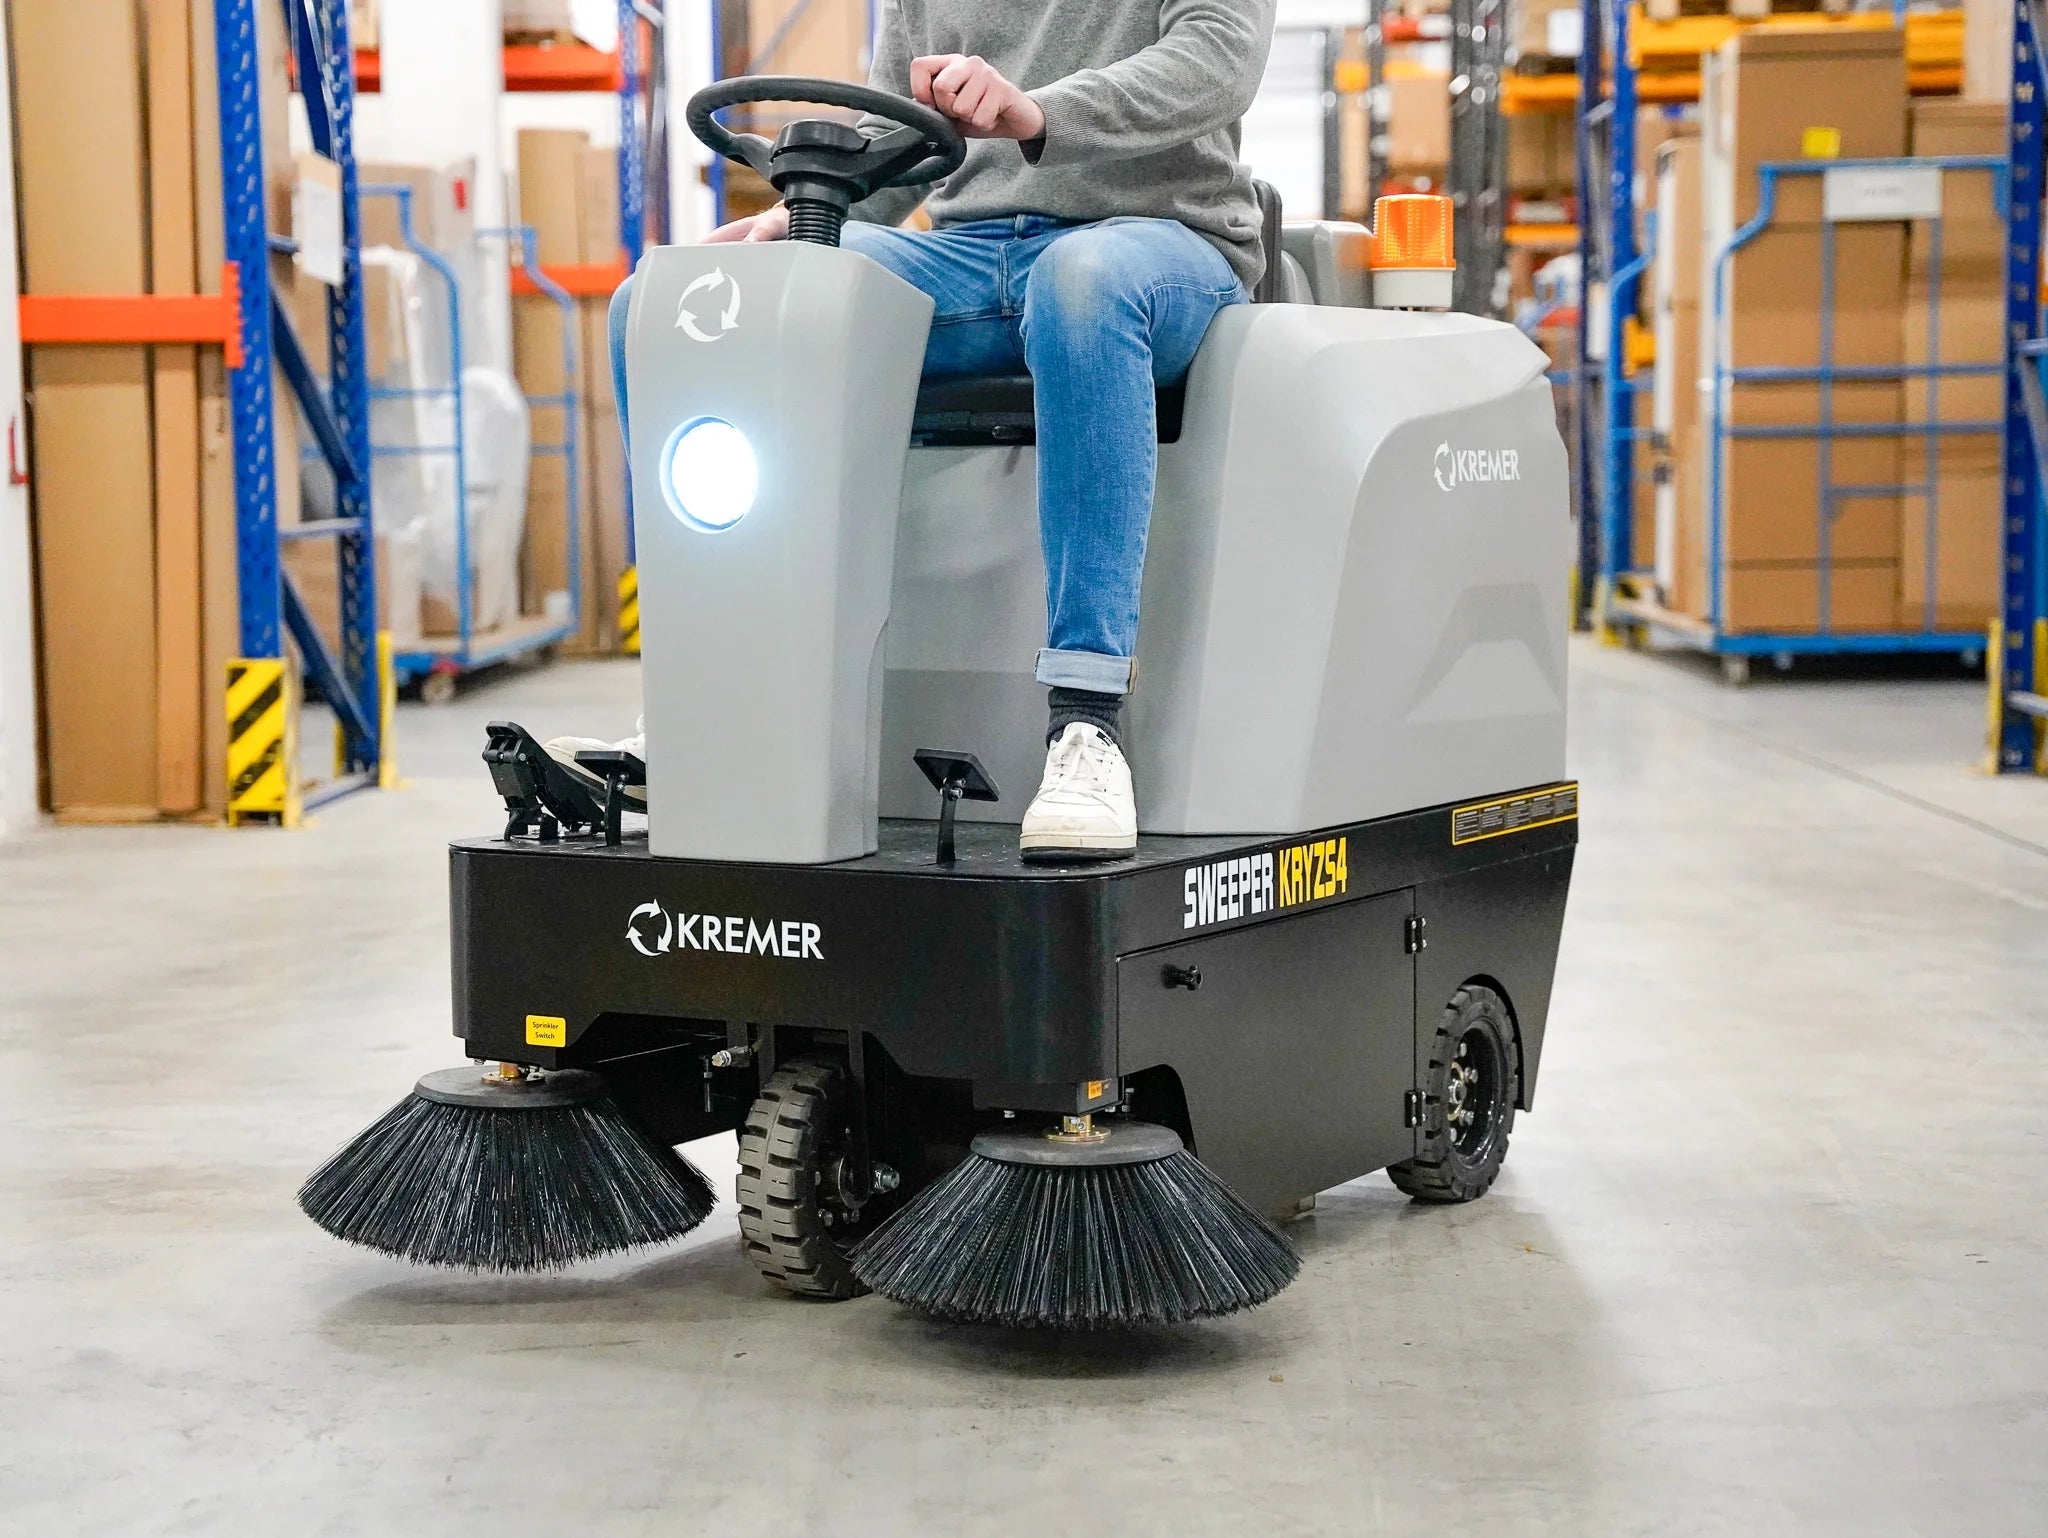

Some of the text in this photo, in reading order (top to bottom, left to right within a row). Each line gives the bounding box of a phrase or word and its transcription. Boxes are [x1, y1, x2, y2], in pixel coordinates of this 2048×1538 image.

[1457, 448, 1521, 482] KREMER
[1184, 836, 1348, 930] SWEEPER KRYZS4
[678, 912, 825, 960] KREMER
[532, 1021, 559, 1030] Sprinkler
[535, 1031, 555, 1040] Switch
